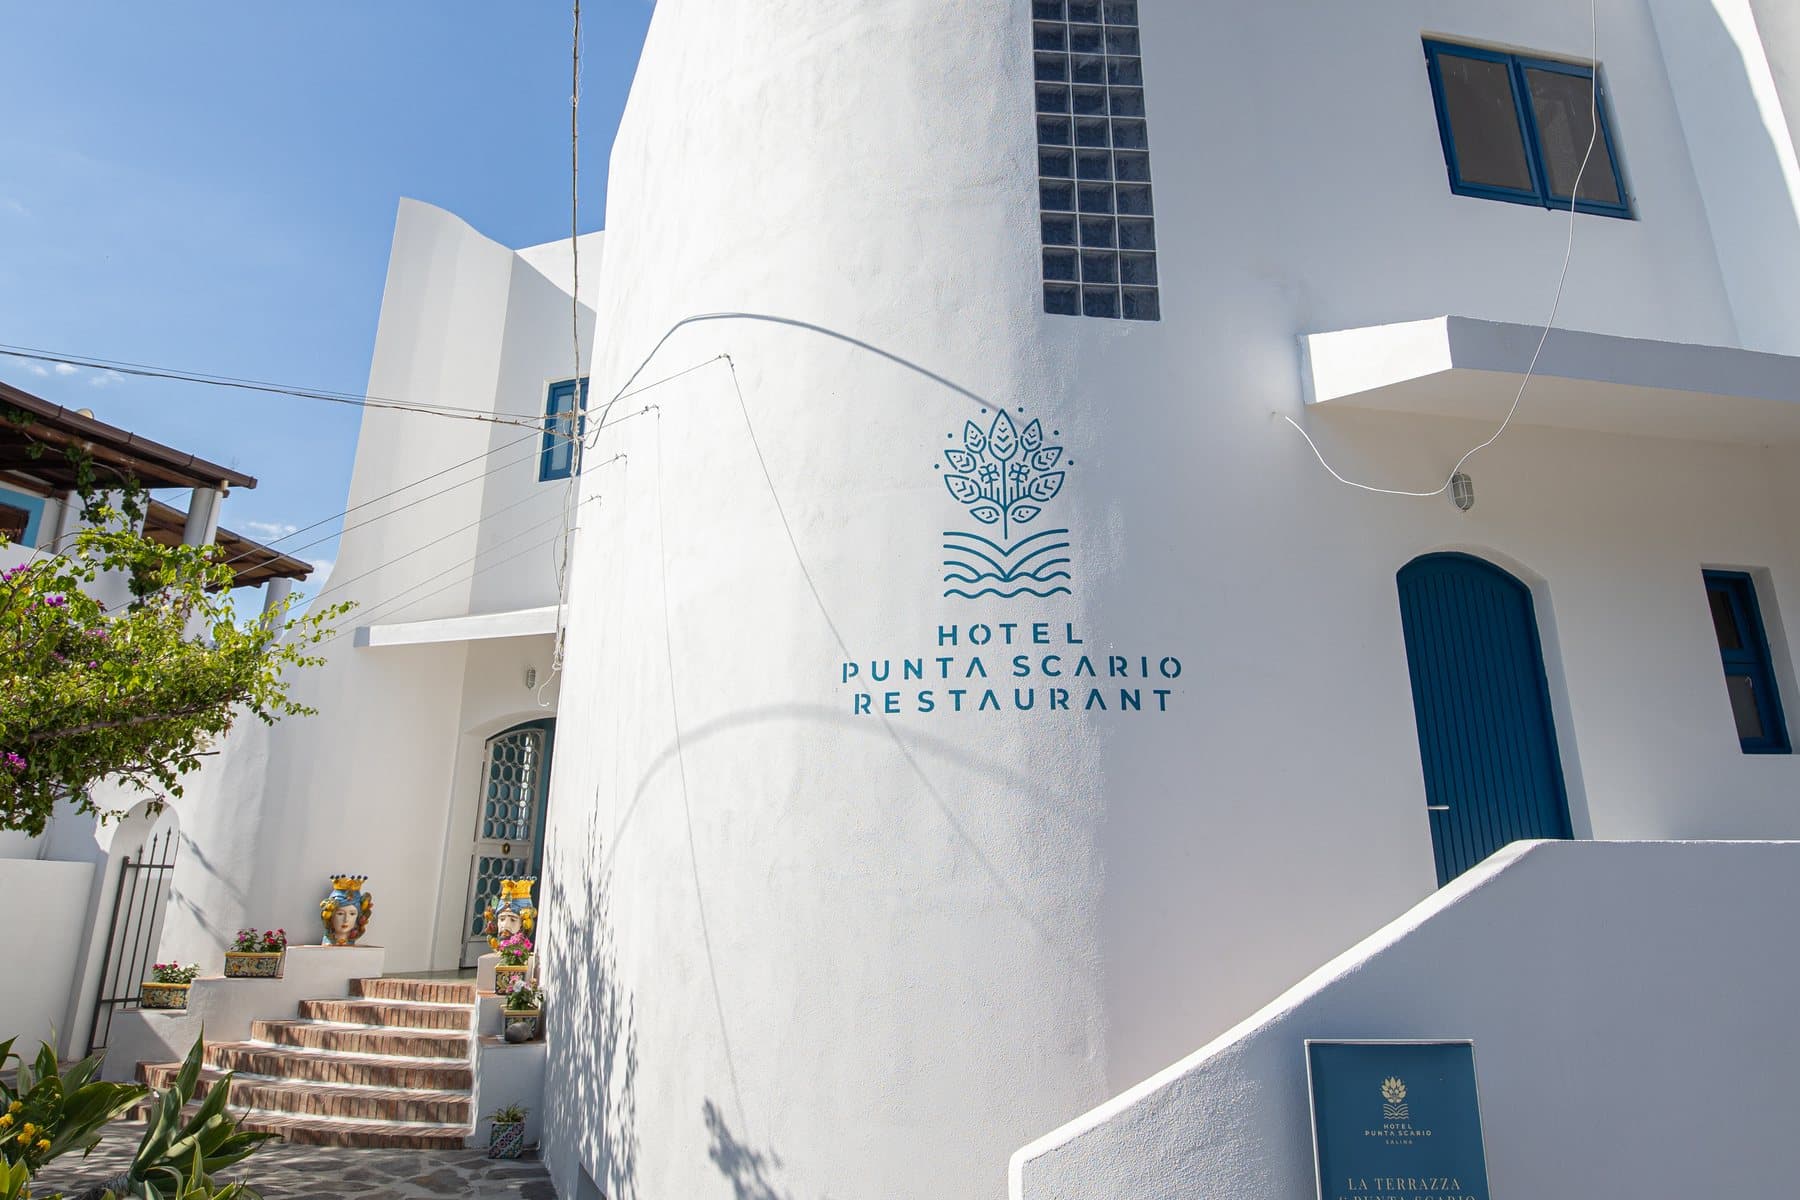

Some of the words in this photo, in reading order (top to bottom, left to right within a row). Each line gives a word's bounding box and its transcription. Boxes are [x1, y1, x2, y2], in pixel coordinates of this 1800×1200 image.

[938, 622, 1083, 646] HOTEL
[842, 656, 988, 683] PUNTA
[1012, 655, 1183, 679] SCARIO
[854, 688, 1172, 715] RESTAURANT
[1348, 1177, 1368, 1191] LA
[1374, 1177, 1461, 1191] TERRAZZA
